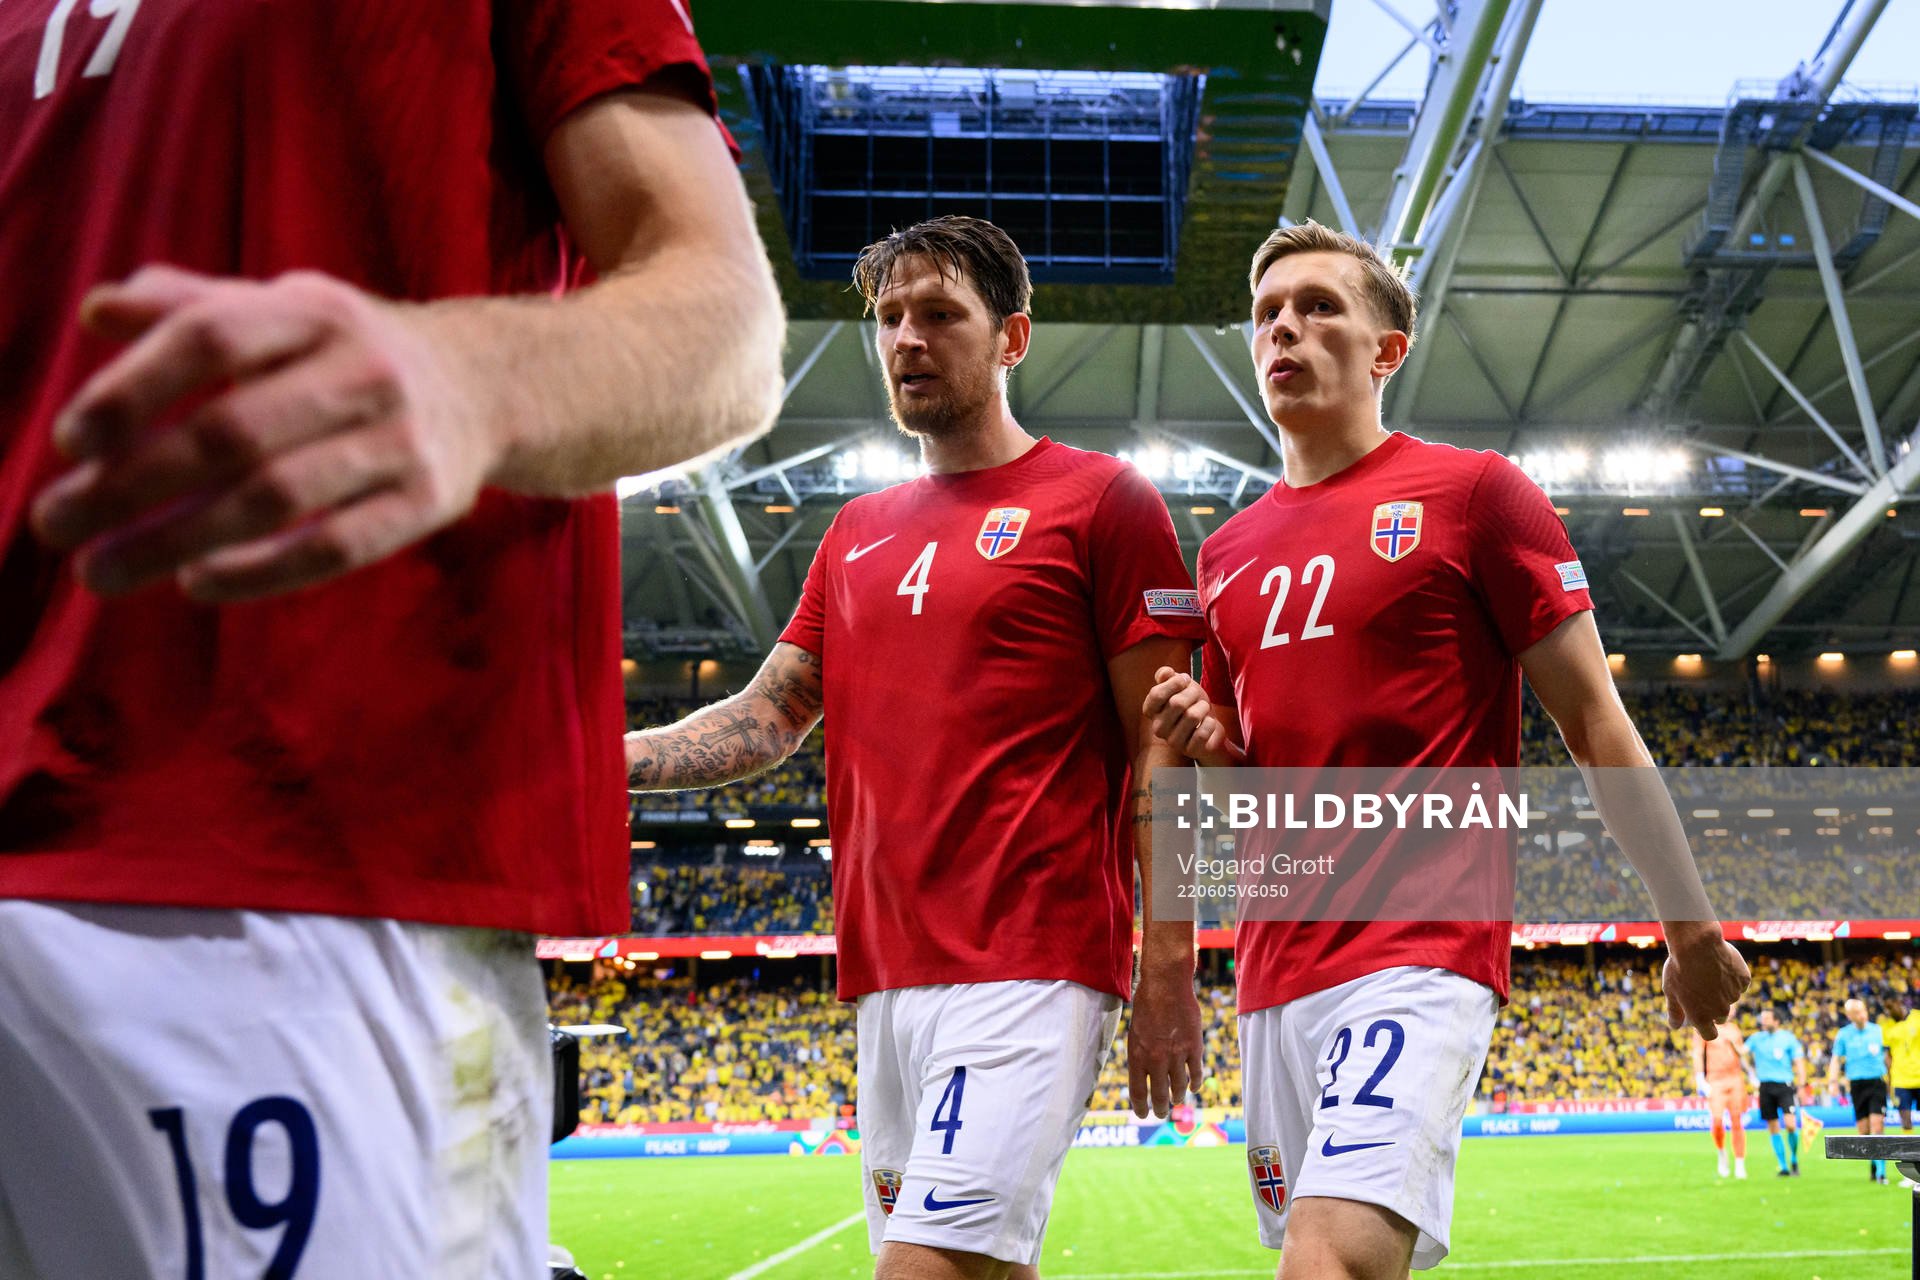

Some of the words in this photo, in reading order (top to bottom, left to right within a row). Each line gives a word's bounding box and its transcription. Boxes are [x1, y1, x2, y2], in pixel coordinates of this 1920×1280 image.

[896, 541, 938, 615] 4
[1259, 554, 1335, 650] 22
[1320, 1019, 1405, 1109] 22
[930, 1066, 967, 1154] 4
[147, 1095, 321, 1280] 19
